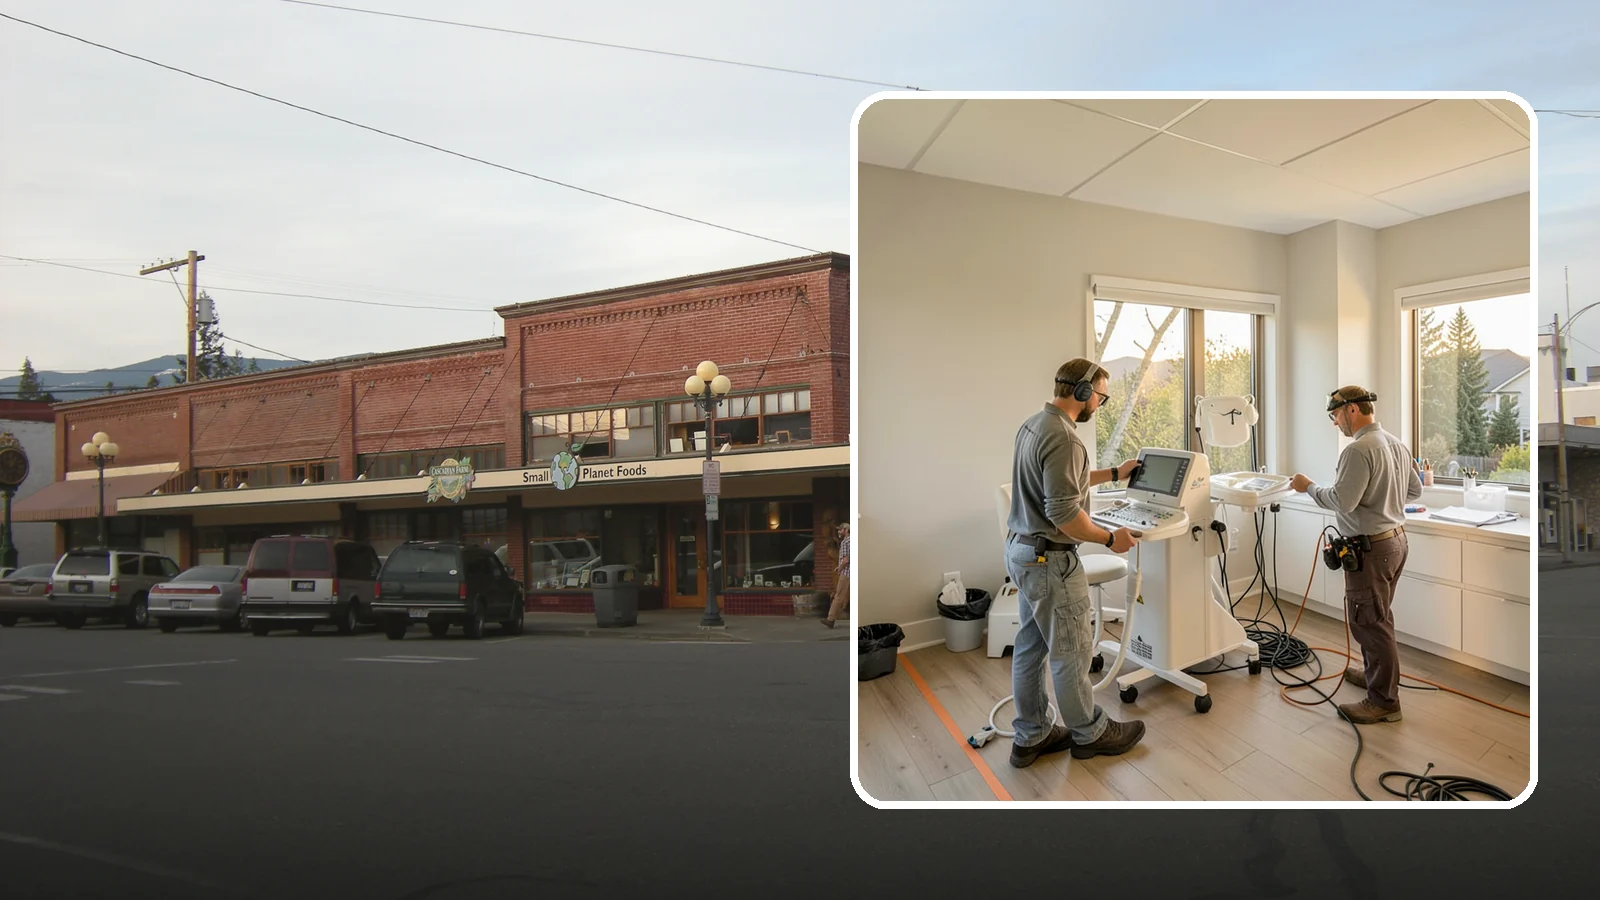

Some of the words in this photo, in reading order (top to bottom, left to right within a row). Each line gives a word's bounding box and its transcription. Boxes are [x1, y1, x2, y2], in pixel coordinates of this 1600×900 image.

[523, 471, 549, 483] Small
[582, 467, 614, 479] Planet
[617, 464, 647, 477] Foods
